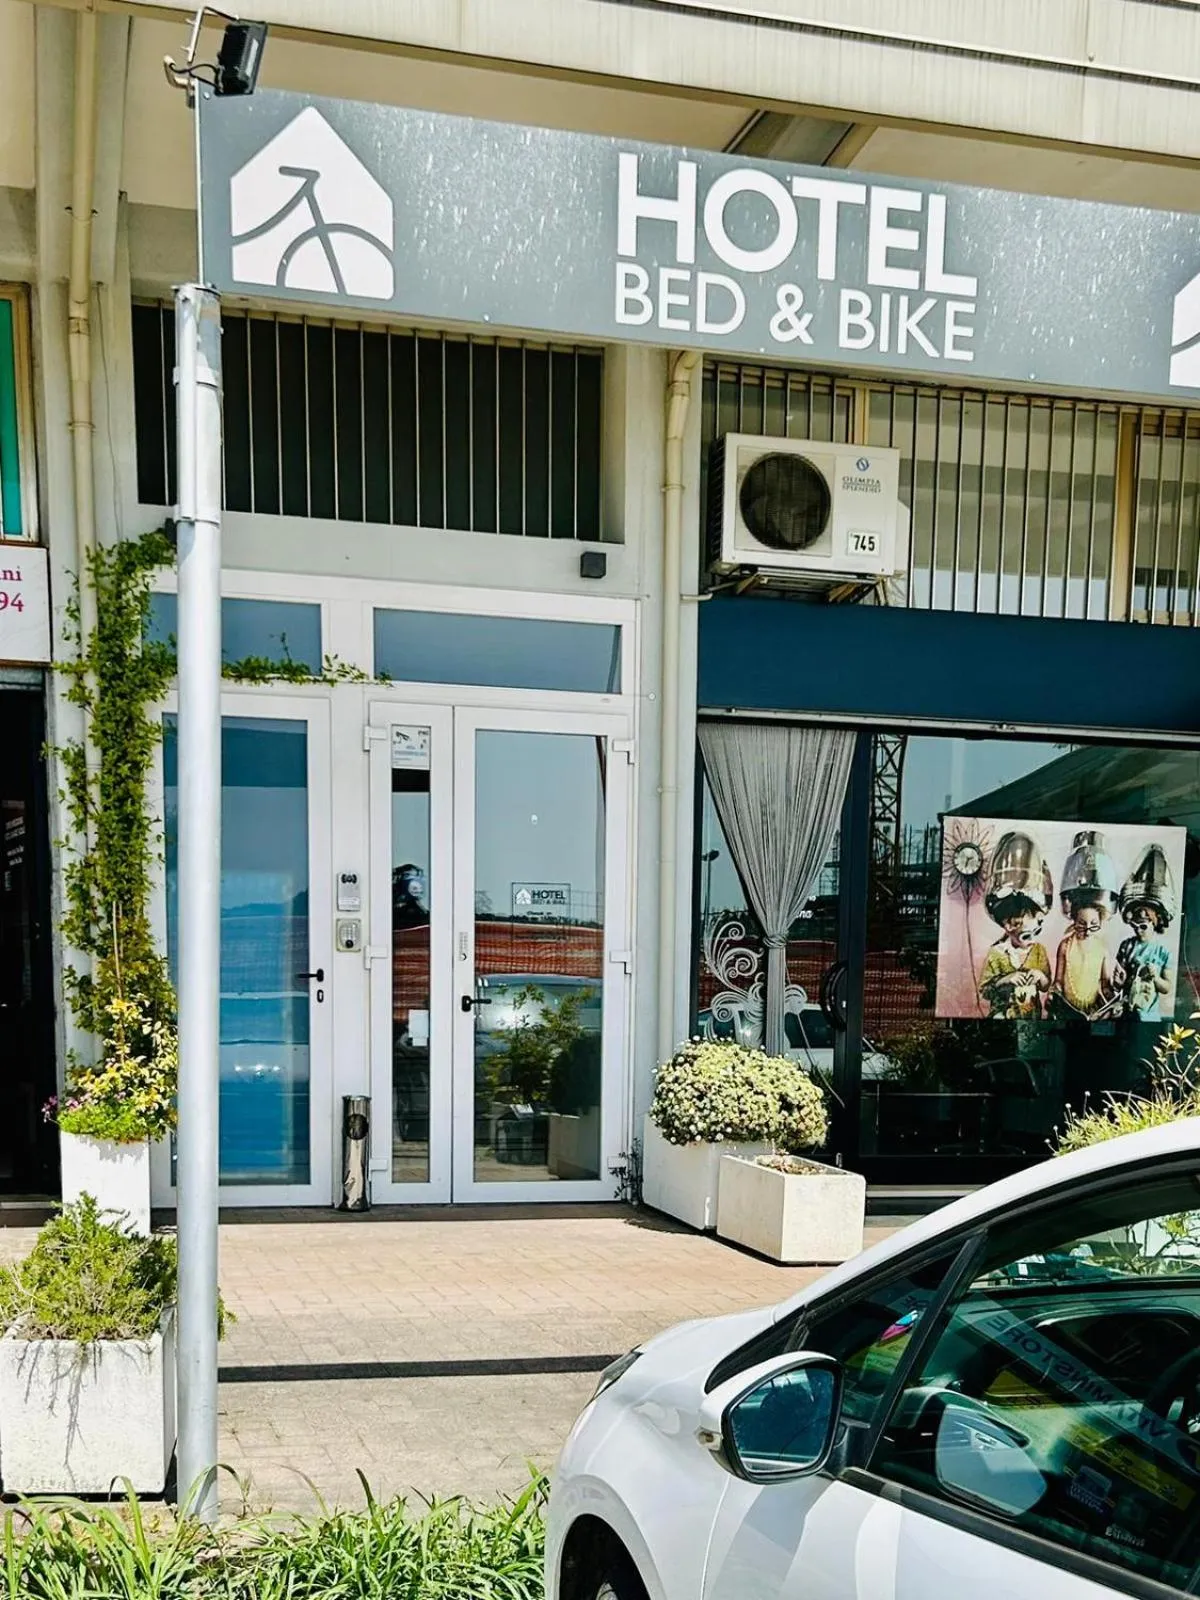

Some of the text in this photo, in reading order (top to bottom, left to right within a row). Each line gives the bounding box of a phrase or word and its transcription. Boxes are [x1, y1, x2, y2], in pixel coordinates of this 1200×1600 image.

[617, 153, 978, 297] HOTEL
[615, 261, 976, 362] BED & BIKE
[853, 534, 876, 552] 745
[0, 565, 23, 581] ni
[532, 890, 566, 900] HOTEL
